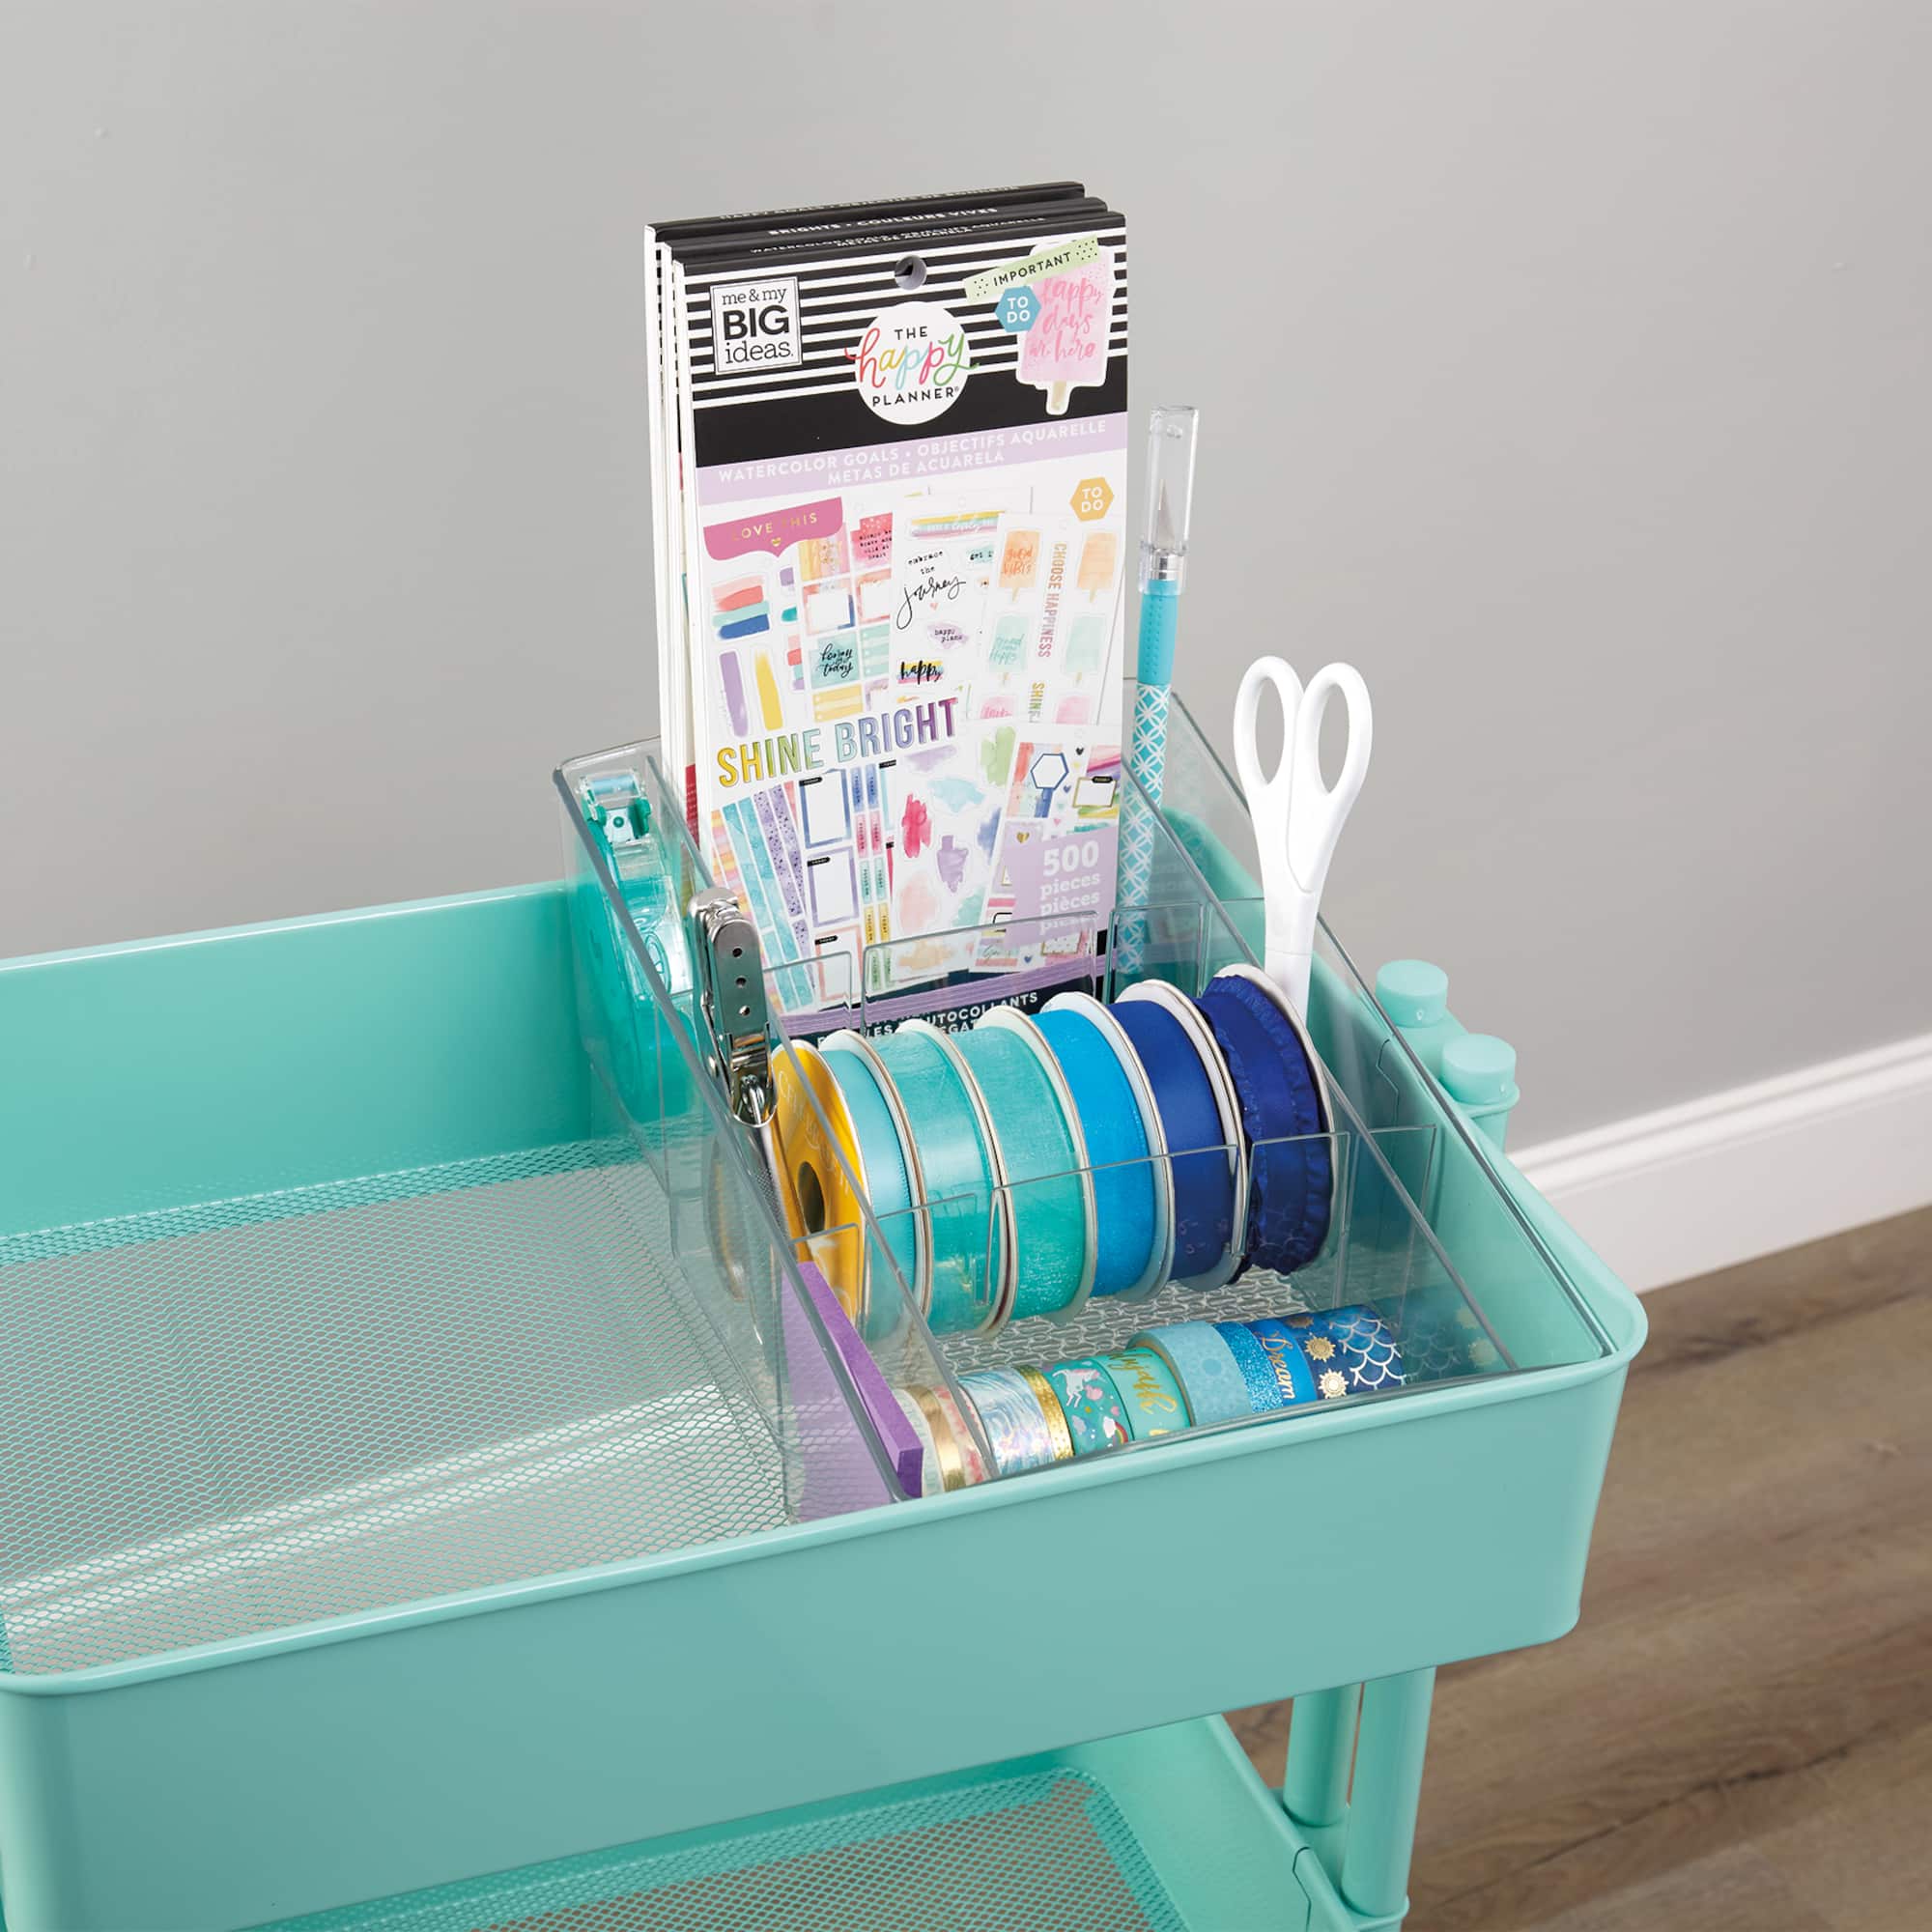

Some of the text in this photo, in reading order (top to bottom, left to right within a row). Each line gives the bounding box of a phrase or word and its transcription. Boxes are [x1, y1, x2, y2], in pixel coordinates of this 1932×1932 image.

[768, 224, 841, 236] BRIGHTS
[857, 213, 946, 227] COULEURS
[948, 207, 998, 217] VIVES
[993, 251, 1071, 287] IMPORTANT
[722, 288, 787, 305] me & my
[1007, 296, 1029, 310] TO
[723, 304, 789, 341] BIG
[1007, 309, 1031, 324] DO
[895, 326, 927, 341] THE
[844, 327, 980, 391] happy
[718, 419, 1106, 483] WATERCOLOR GOALS OBJECTIFS AQUARELLE
[828, 450, 1005, 485] METAS DE ACUARELA
[1081, 486, 1103, 499] TO
[1081, 498, 1103, 513] DO
[895, 576, 967, 630] journey
[1037, 542, 1067, 659] CHOOSE HAPPINESS
[899, 660, 944, 685] happy
[717, 696, 959, 788] SHINE BRIGHT
[1043, 839, 1100, 877] 500
[1039, 872, 1101, 900] pieces
[1039, 890, 1101, 917] pièces
[1260, 1330, 1296, 1400] Dream
